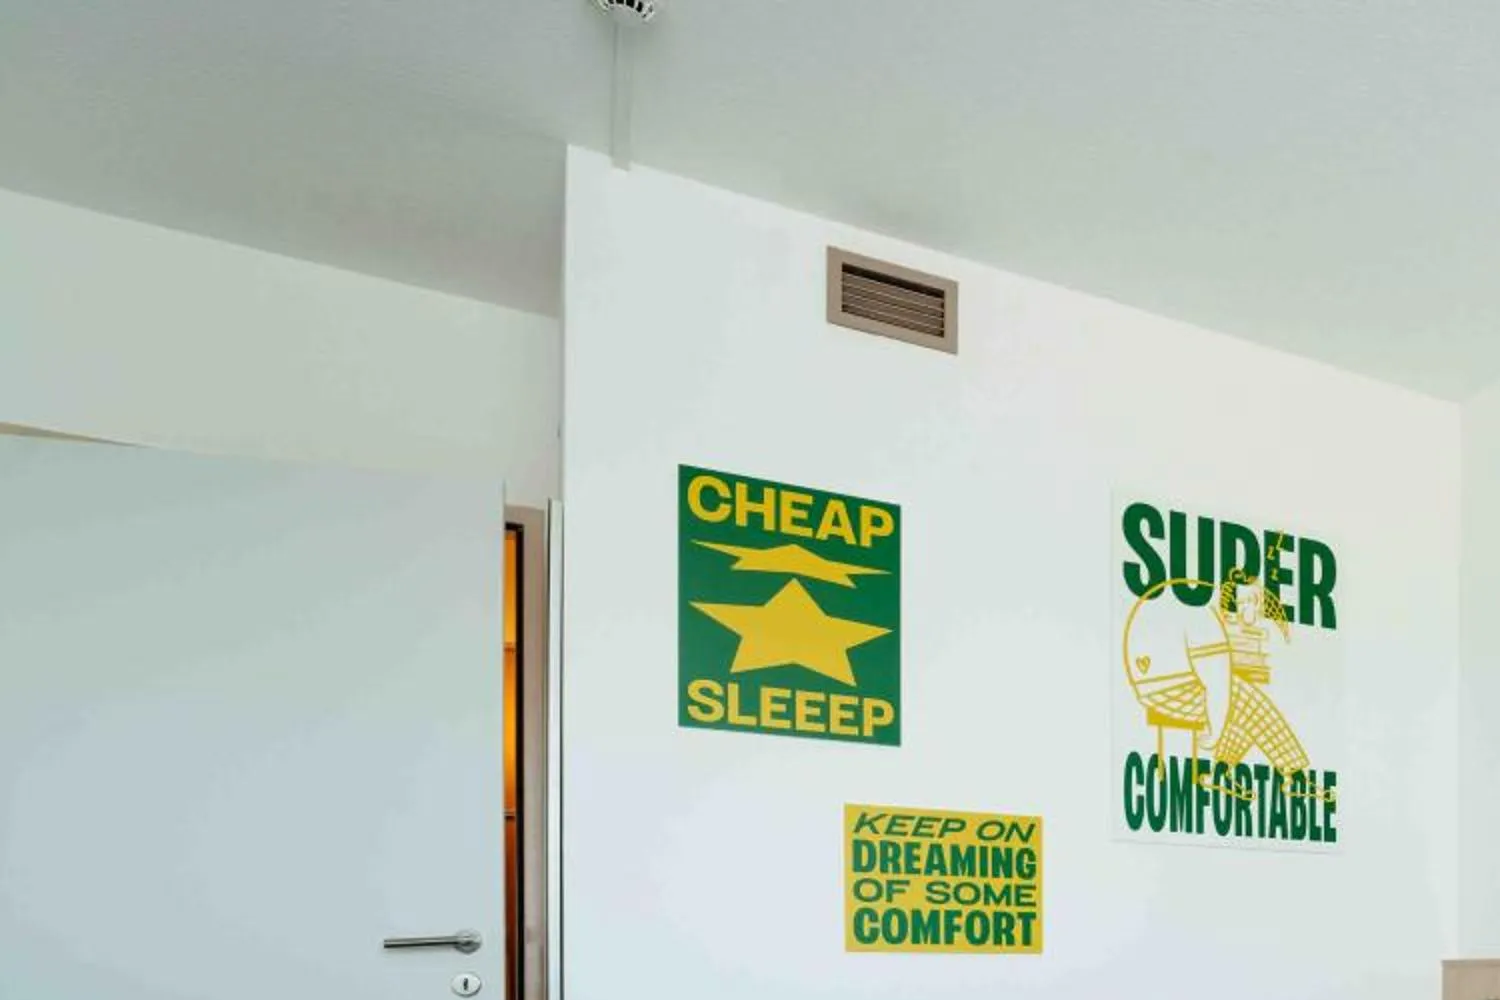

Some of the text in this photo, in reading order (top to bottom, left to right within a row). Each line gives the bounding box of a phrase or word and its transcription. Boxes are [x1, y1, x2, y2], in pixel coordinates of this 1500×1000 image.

[687, 475, 894, 548] CHEAP
[1122, 502, 1337, 630] SUPER
[687, 679, 894, 737] SLEEEP
[1123, 751, 1337, 842] COMFORTABLE
[853, 811, 1035, 843] KEEP ON
[852, 839, 1037, 880] DREAMING
[853, 878, 1037, 907] OF SOME
[853, 907, 1037, 946] COMFORT
